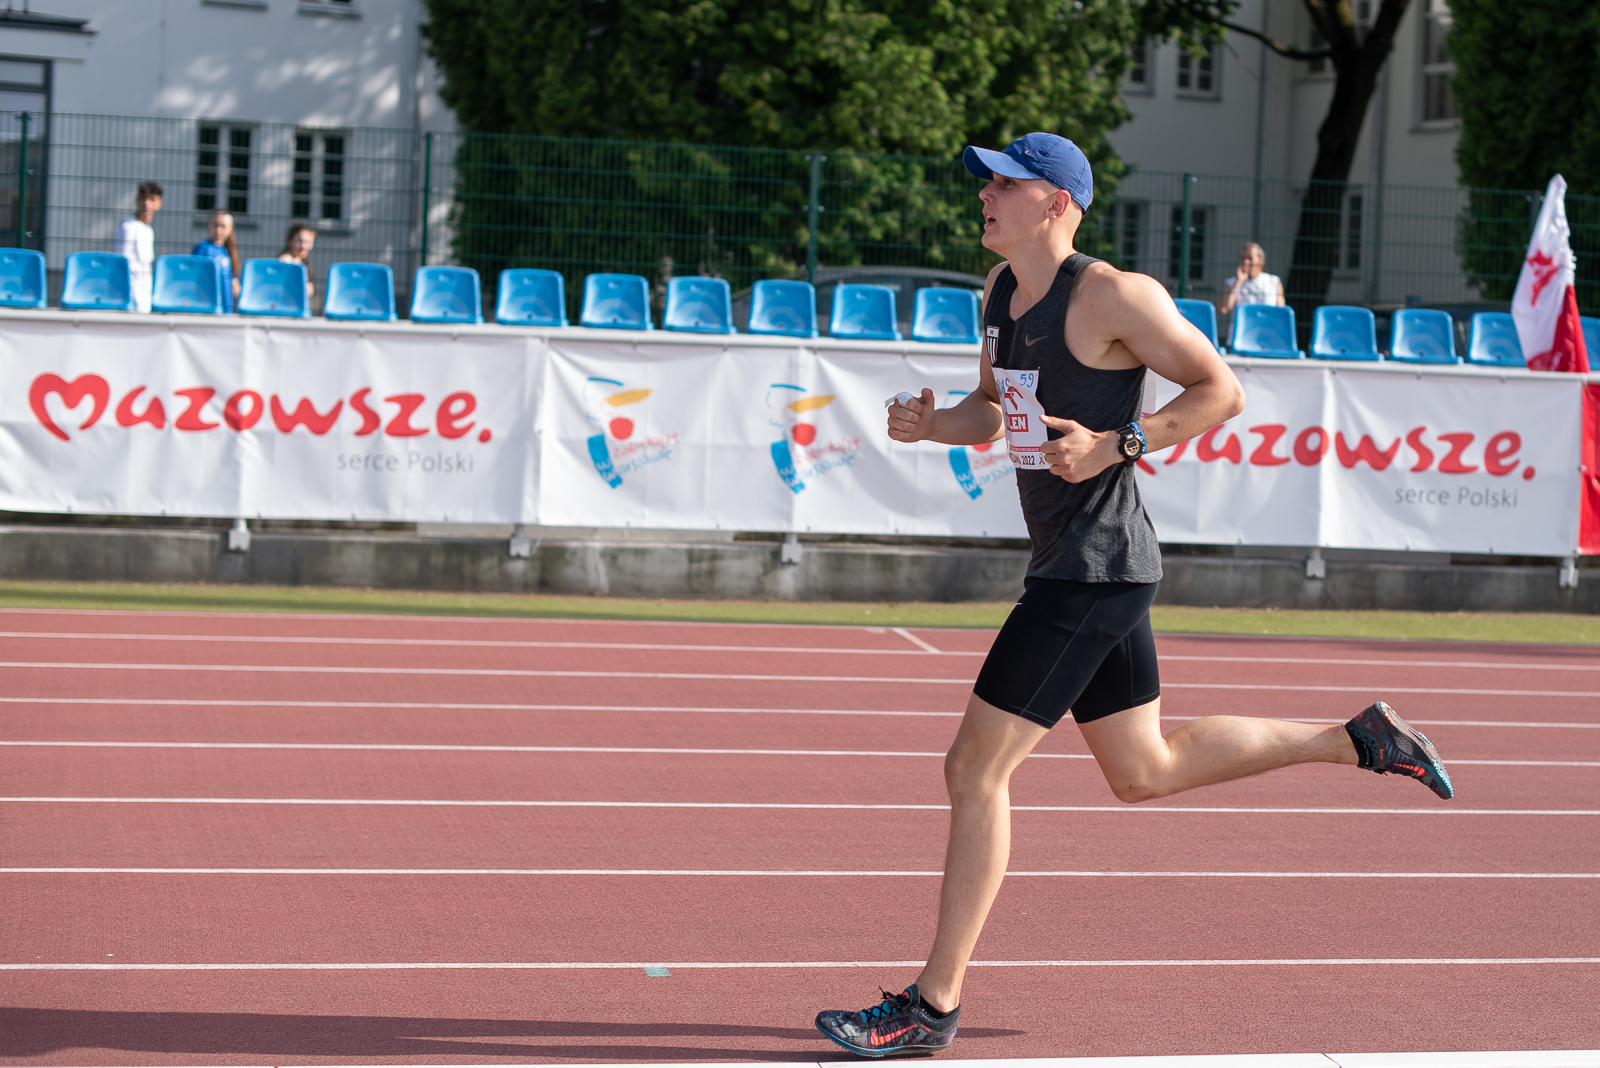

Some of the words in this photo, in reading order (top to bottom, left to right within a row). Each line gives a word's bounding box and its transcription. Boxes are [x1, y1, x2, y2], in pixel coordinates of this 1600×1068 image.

[1019, 372, 1034, 388] 59
[337, 453, 399, 472] serce
[408, 450, 474, 473] Polski
[1021, 454, 1035, 466] 2022
[1394, 488, 1450, 506] serce
[1458, 485, 1519, 508] Polski
